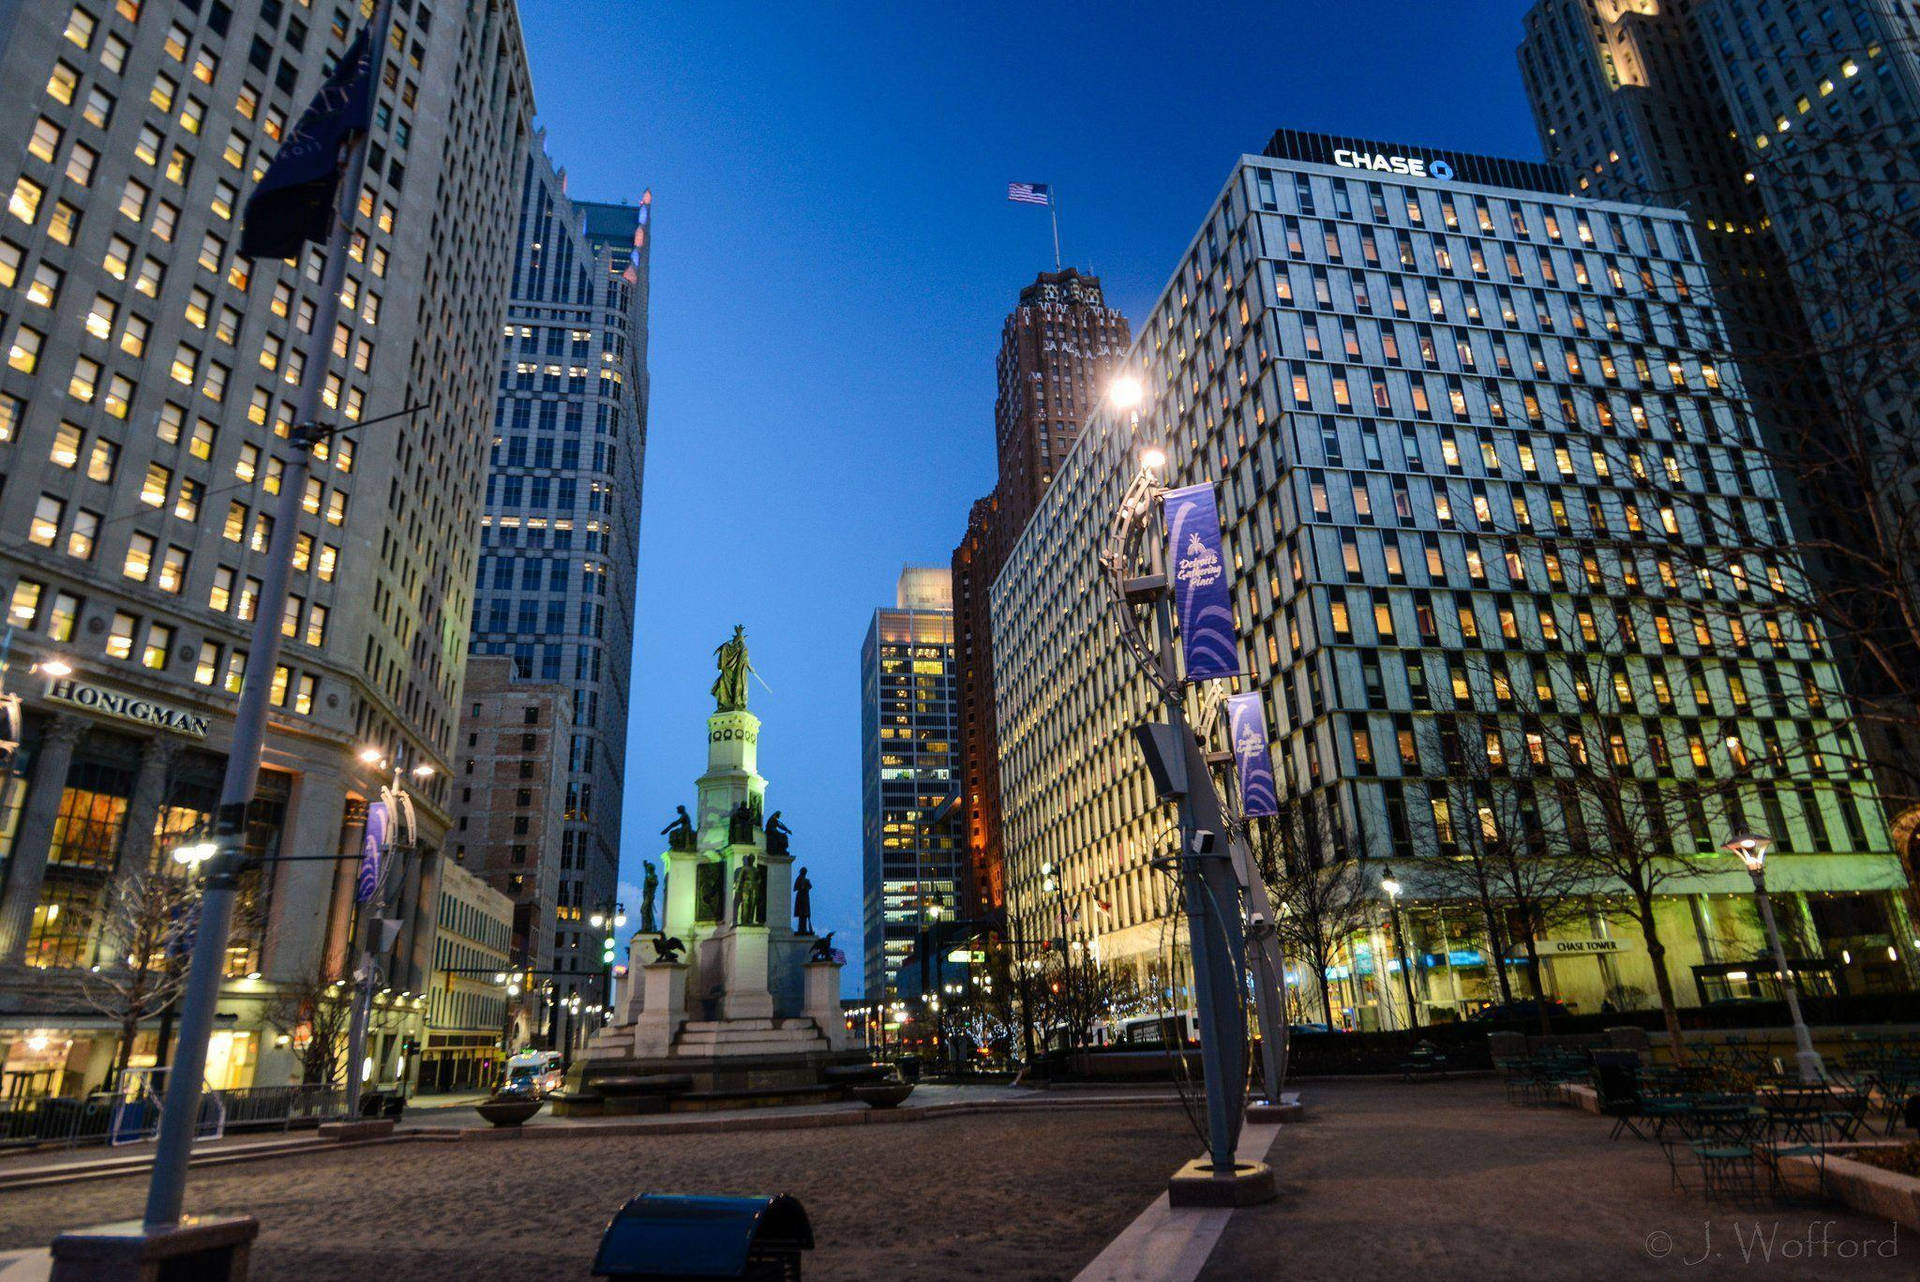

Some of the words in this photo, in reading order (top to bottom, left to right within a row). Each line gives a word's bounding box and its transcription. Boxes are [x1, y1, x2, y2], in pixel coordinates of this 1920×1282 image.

[1334, 149, 1427, 177] CHASE
[1179, 553, 1218, 569] Detroit's
[1177, 565, 1222, 581] Gathering
[52, 679, 211, 737] HONIGMAN
[1557, 942, 1585, 952] CHASE
[1587, 941, 1617, 951] TOWER
